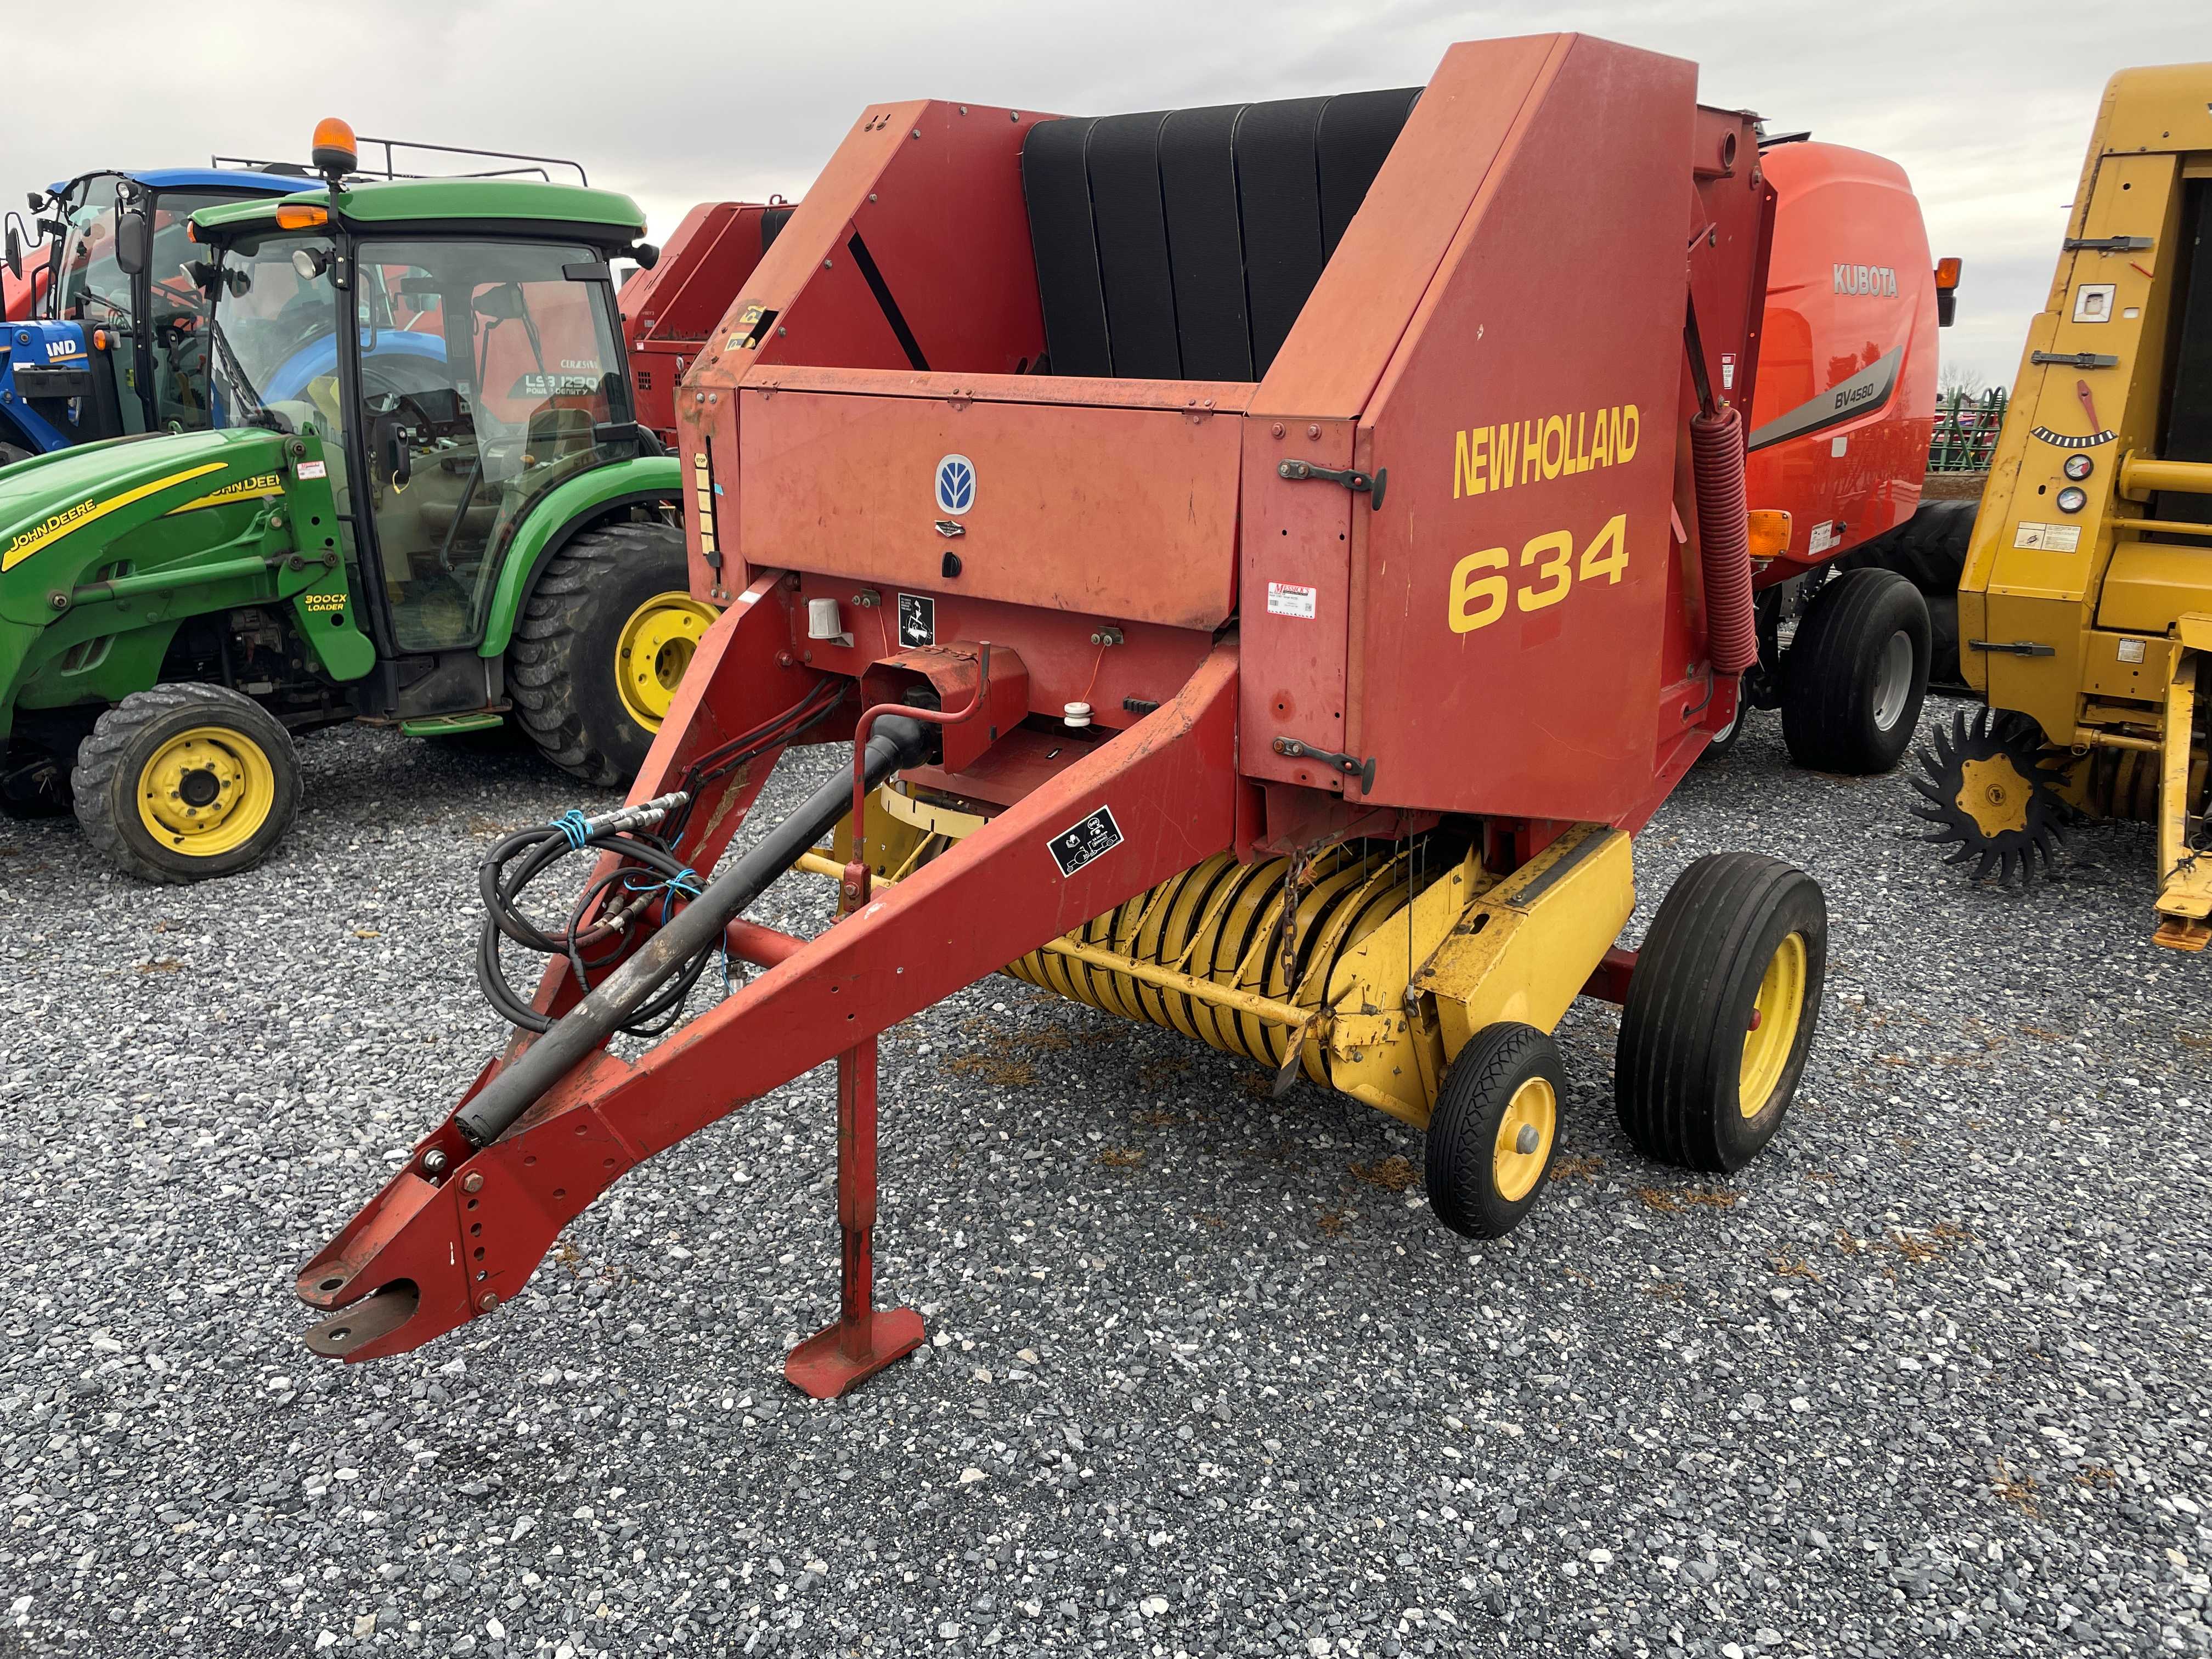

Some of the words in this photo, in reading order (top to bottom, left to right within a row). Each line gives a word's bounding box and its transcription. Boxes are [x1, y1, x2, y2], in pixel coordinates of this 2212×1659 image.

[1833, 263, 1898, 298] KUBOTA
[1835, 383, 1874, 410] BV4580
[1454, 421, 1520, 499] NEW
[1521, 404, 1639, 484] HOLLAND
[10, 524, 48, 552] JOHN
[47, 499, 96, 531] DEERE
[1448, 514, 1629, 634] 634
[305, 594, 347, 603] 300CX
[308, 603, 343, 612] LOADER
